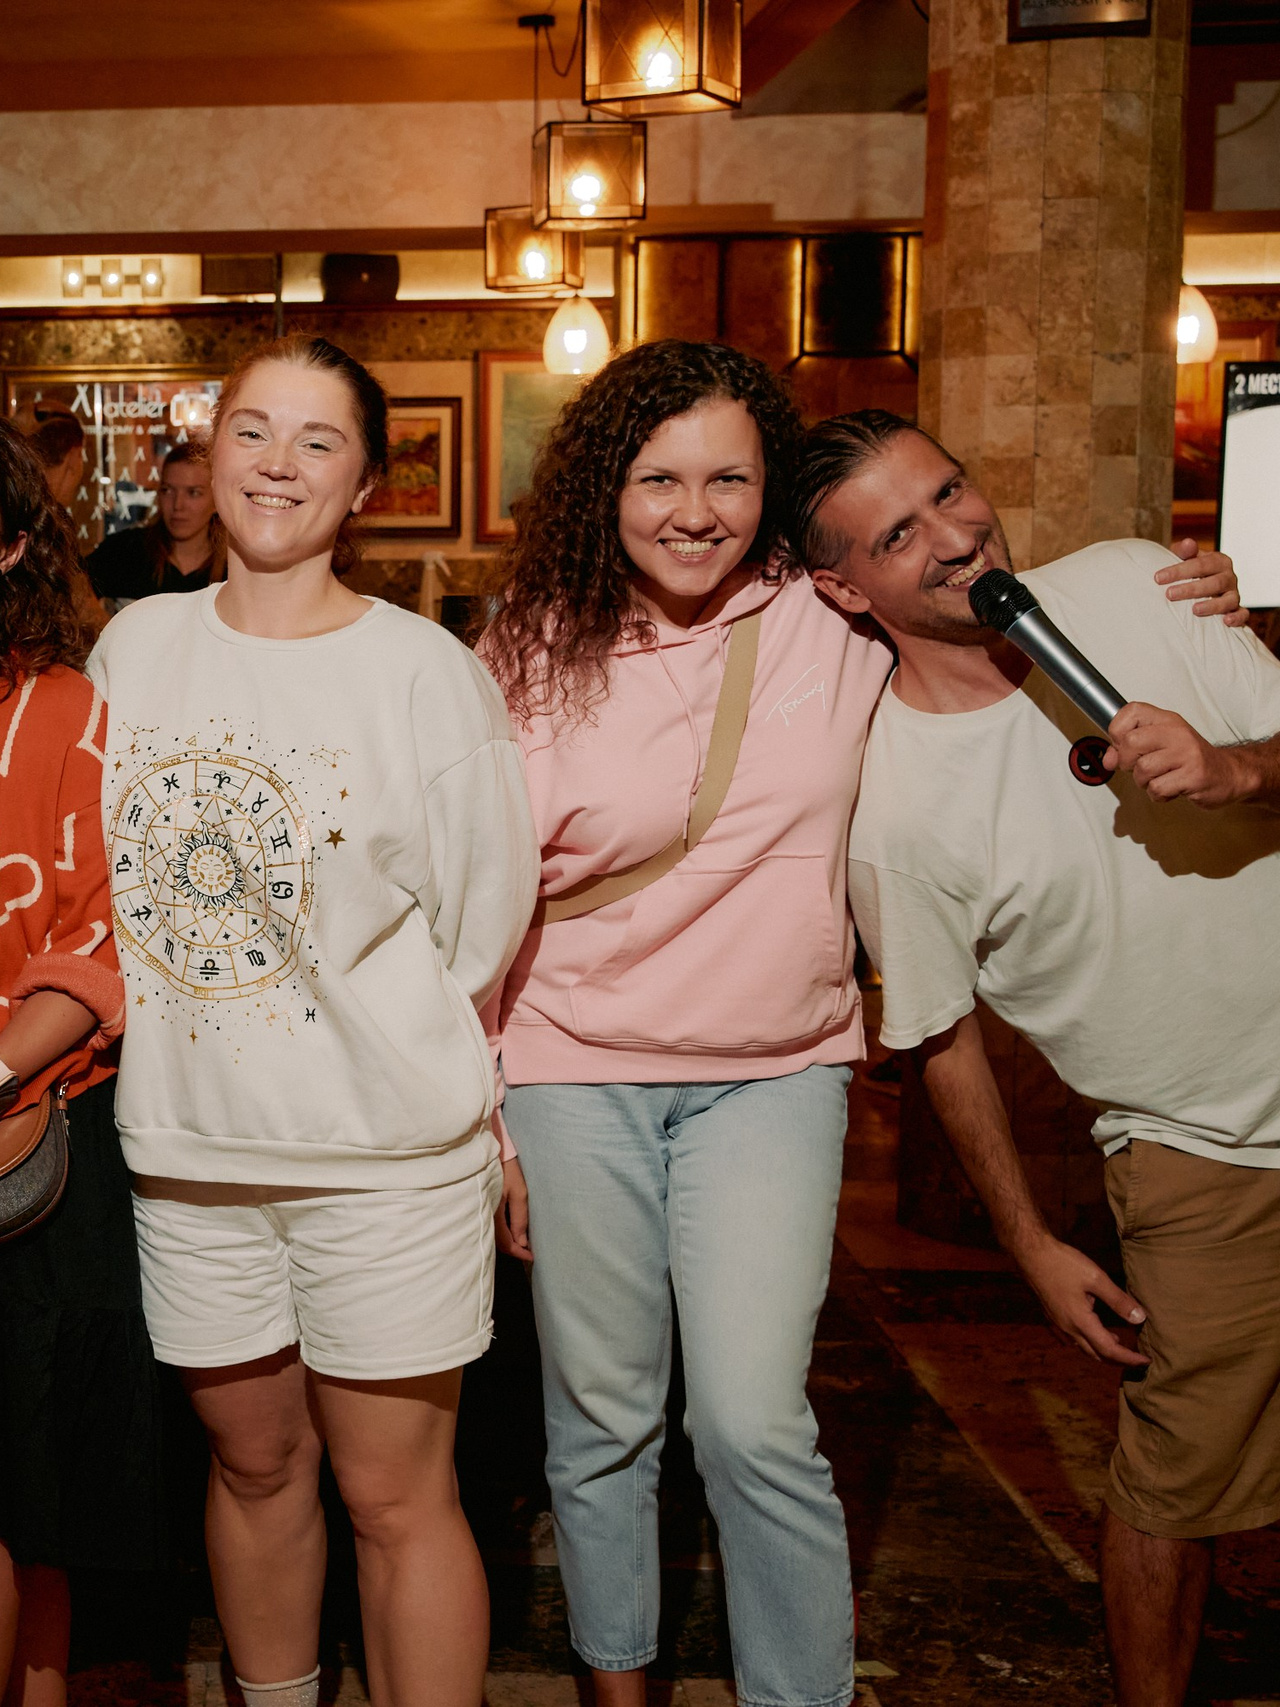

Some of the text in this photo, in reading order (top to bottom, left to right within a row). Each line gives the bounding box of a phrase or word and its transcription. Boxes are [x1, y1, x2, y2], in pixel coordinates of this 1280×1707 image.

[1234, 373, 1280, 395] 2 МЕС
[103, 385, 167, 418] atelier
[153, 756, 181, 773] Pisces
